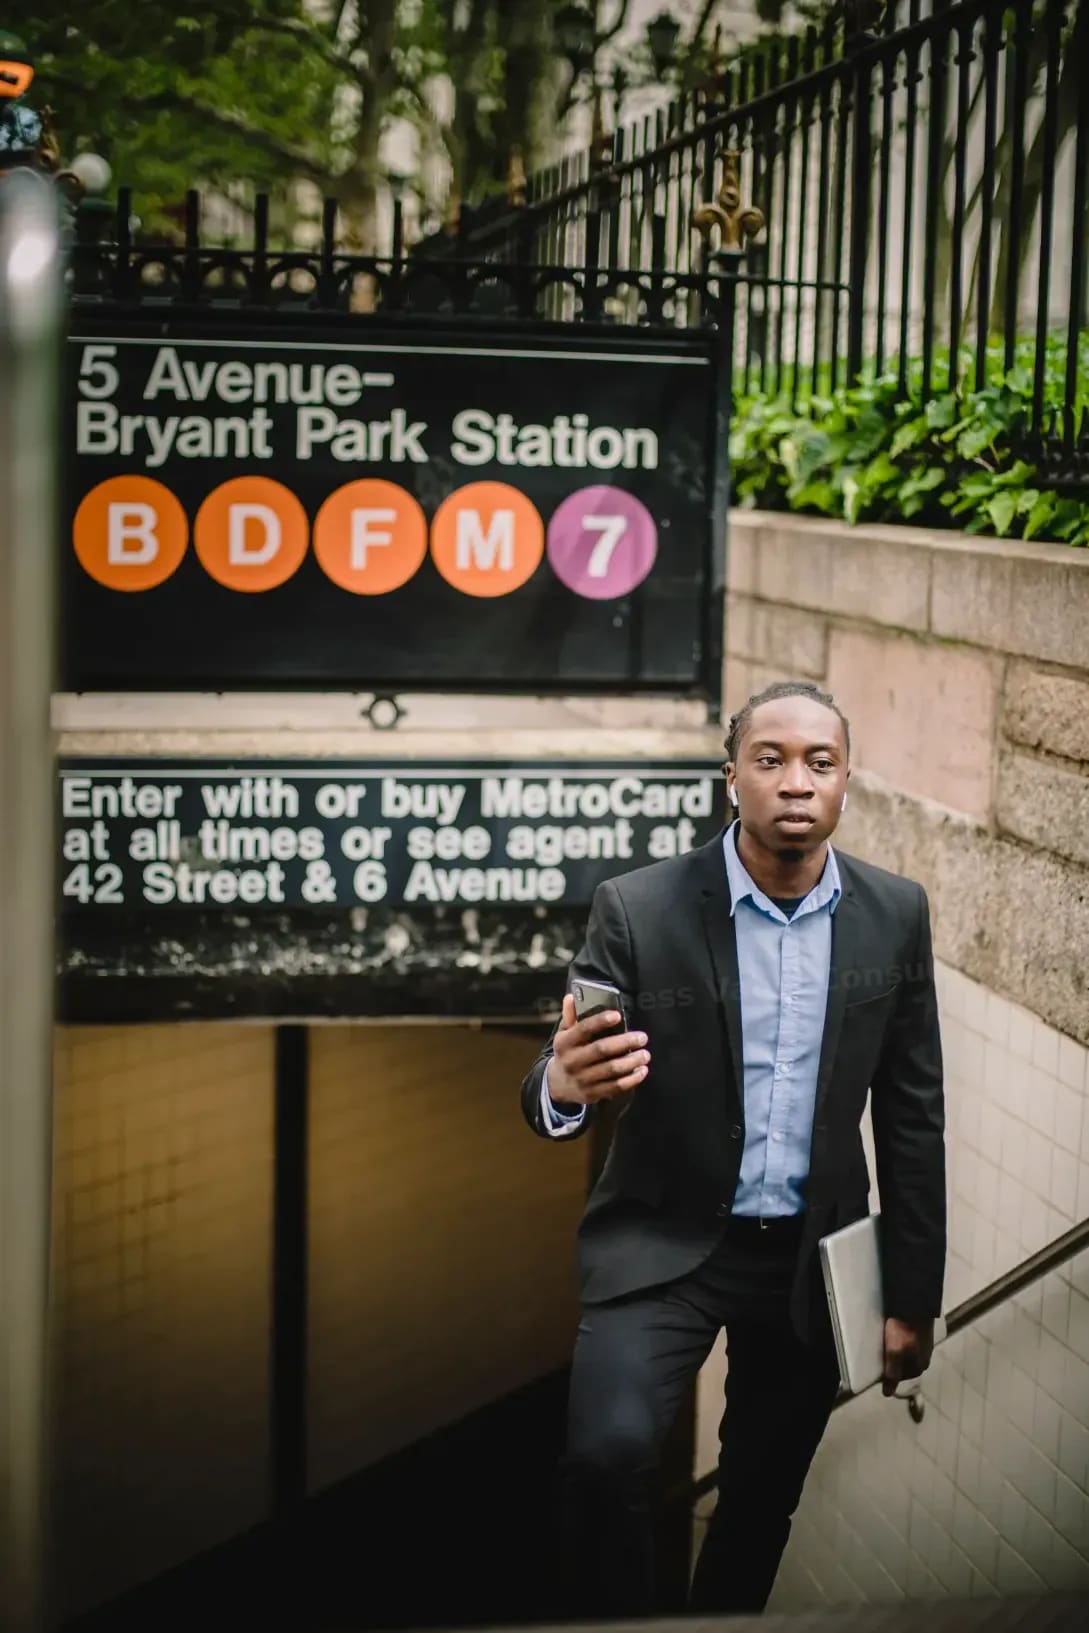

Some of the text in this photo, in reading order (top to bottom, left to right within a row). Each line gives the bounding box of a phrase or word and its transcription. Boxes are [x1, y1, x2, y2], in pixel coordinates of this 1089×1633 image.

[78, 345, 118, 398] 5
[76, 401, 658, 469] Bryant Park Station
[109, 503, 630, 580] B D F M 7
[62, 776, 713, 826] Enter with or buy MetroCard
[63, 820, 696, 871] at all times or see agent at
[63, 861, 567, 904] 42 Street & 6 Avenue
